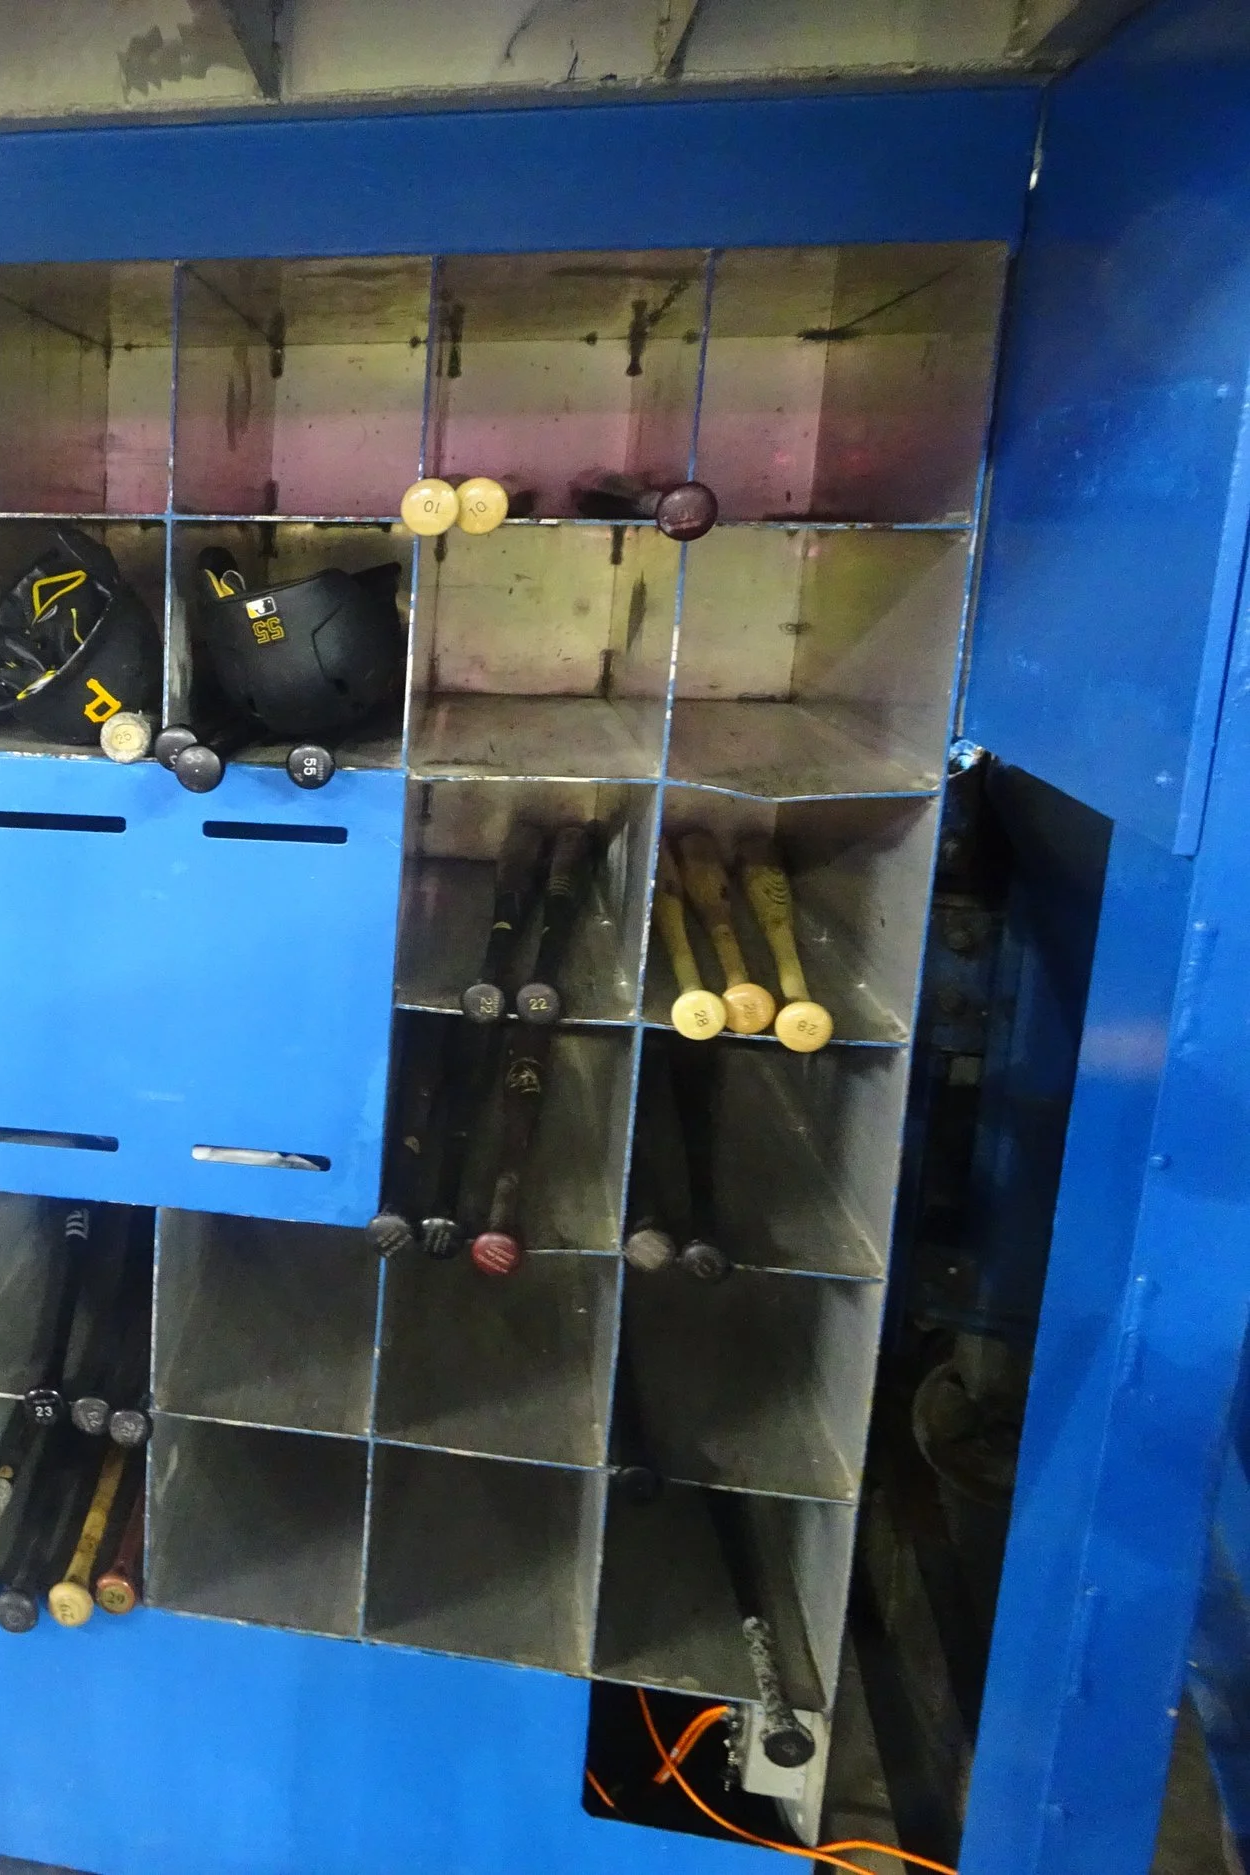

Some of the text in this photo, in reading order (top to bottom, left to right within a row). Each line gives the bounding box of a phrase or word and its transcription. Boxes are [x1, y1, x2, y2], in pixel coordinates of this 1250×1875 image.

[303, 757, 317, 776] 55
[529, 998, 548, 1010] 22
[35, 1406, 53, 1417] 23
